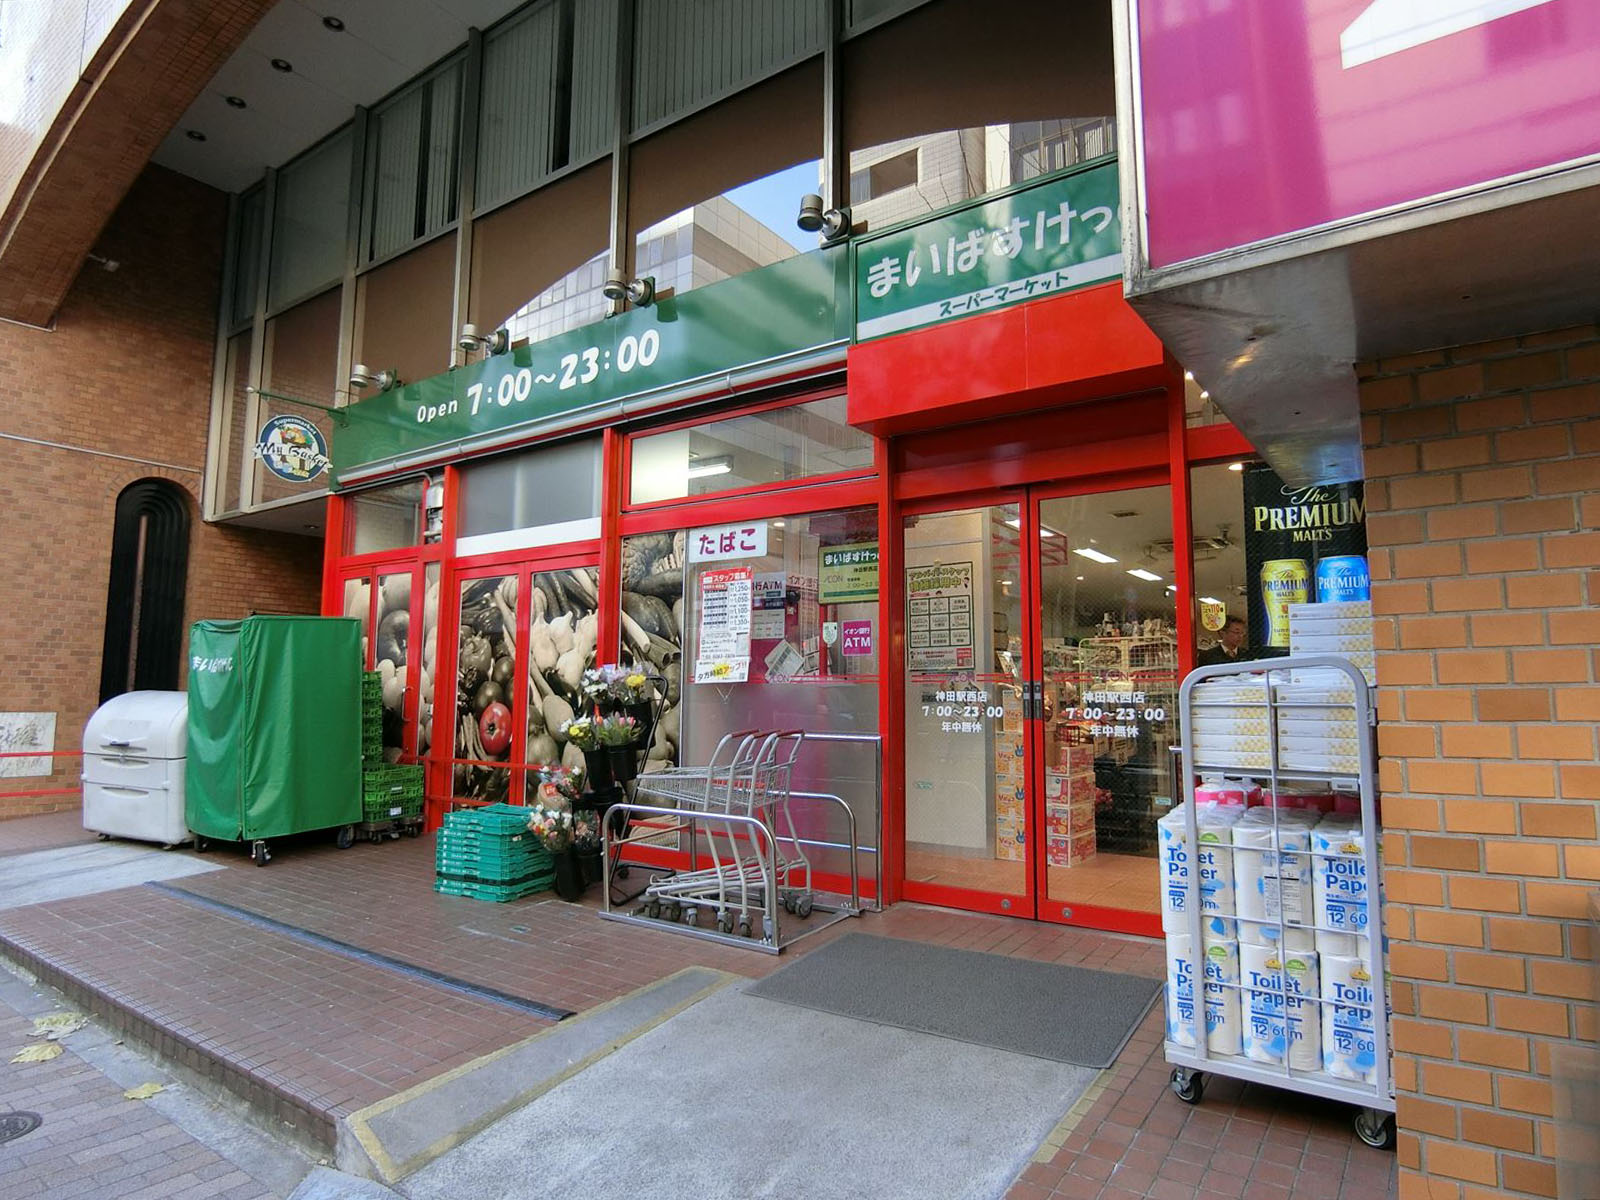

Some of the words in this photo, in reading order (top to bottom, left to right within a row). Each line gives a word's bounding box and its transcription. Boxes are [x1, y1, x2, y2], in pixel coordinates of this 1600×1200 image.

[867, 201, 1121, 299] まいばすけっ
[939, 271, 1069, 317] スーパーマーケット
[417, 398, 458, 424] Open
[274, 417, 317, 435] Supermarket
[256, 442, 283, 456] My
[289, 445, 329, 468] Basket
[1281, 485, 1339, 505] The
[1254, 497, 1367, 532] PREMIUM
[699, 527, 757, 555] たばこ
[1319, 574, 1369, 590] PREMIUM
[844, 627, 870, 636] イオン銀行
[844, 637, 871, 648] ATM
[936, 691, 988, 703] 神田駅西店
[1082, 691, 1146, 704] 神田駅西店
[941, 721, 983, 733] 年中無休
[1089, 725, 1139, 738] 年中無休
[1167, 847, 1215, 865] Toet
[1168, 862, 1218, 880] Paer
[1171, 897, 1184, 907] 12
[1328, 912, 1344, 923] 12
[1249, 971, 1301, 993] Toilet
[1251, 989, 1304, 1008] Paper
[1180, 1010, 1193, 1020] 12
[1252, 1024, 1267, 1036] 12
[1336, 1038, 1352, 1050] 12
